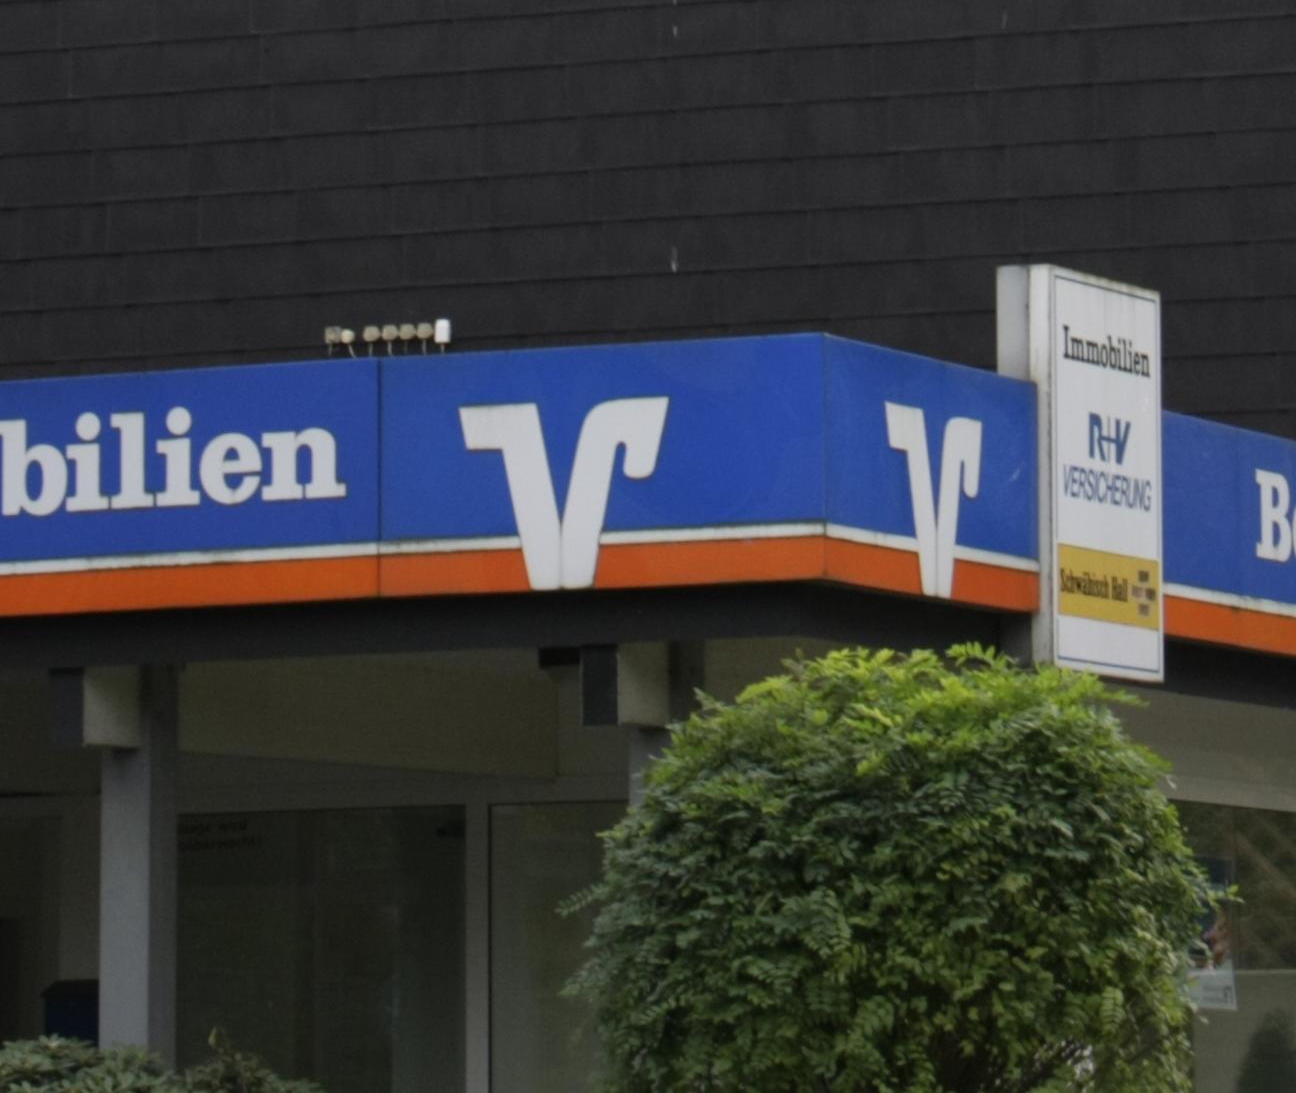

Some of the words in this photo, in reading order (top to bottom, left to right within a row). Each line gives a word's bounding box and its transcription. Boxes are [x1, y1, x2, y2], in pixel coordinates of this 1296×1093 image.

[1062, 323, 1151, 378] Immobilien
[1063, 464, 1152, 513] VERSICHERUNG
[1111, 576, 1129, 603] Hall
